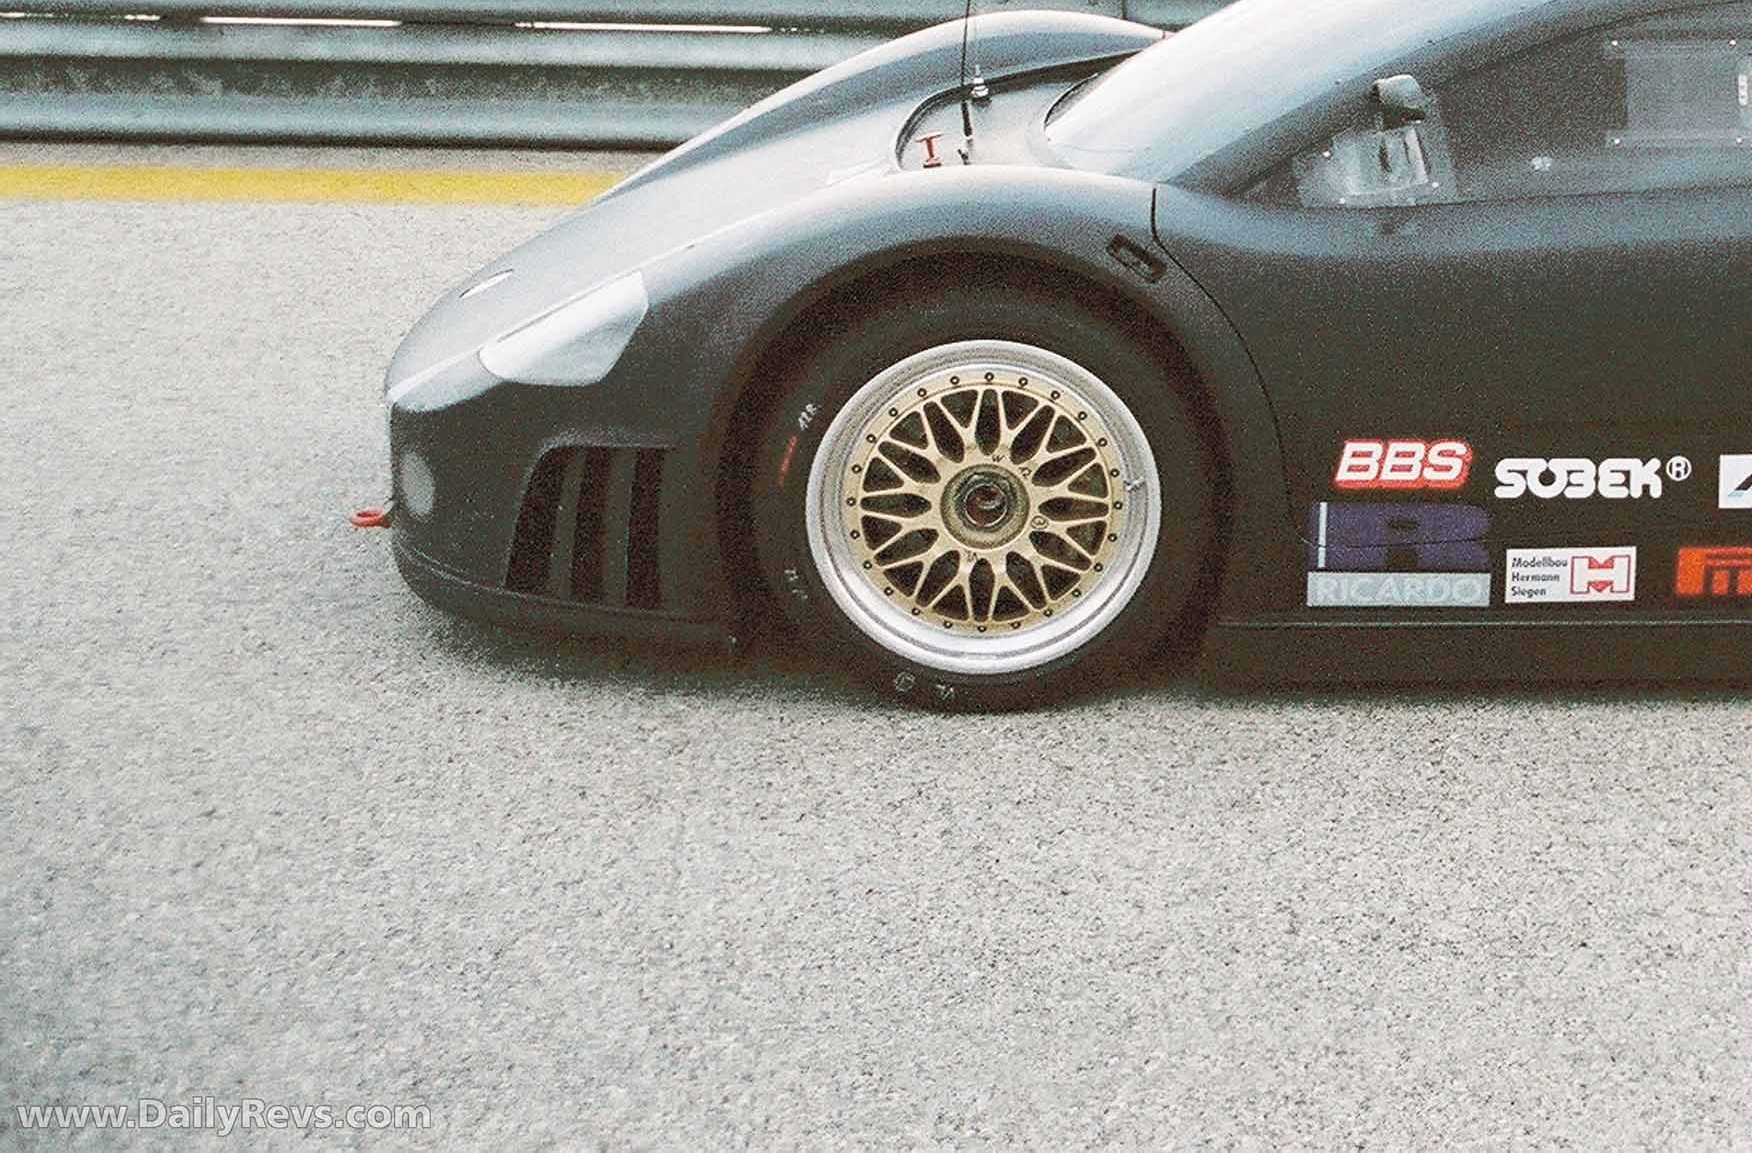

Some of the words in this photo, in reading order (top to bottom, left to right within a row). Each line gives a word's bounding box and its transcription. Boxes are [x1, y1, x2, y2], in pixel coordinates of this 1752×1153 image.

[1333, 439, 1471, 487] BBS
[1511, 572, 1560, 582] Hermann
[1314, 577, 1484, 603] RICARDO
[1511, 586, 1547, 598] Siegen
